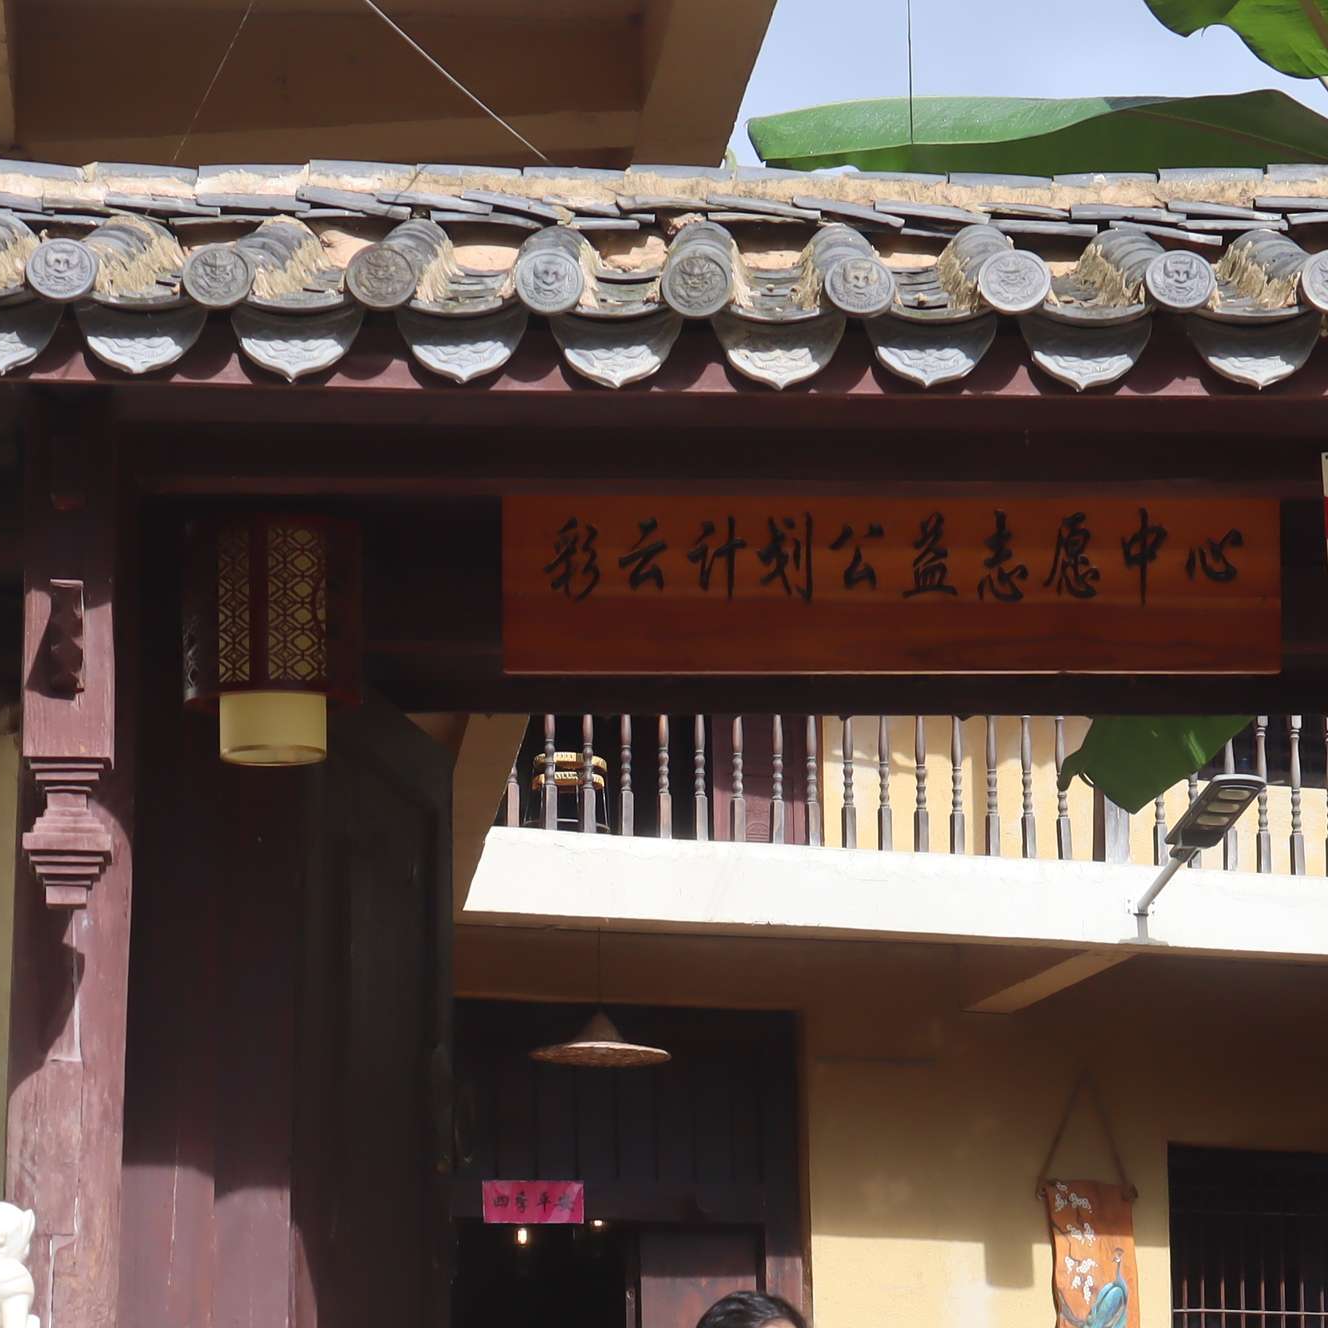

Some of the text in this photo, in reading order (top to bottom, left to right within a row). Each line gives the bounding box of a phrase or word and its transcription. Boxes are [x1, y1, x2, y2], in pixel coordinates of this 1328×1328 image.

[543, 507, 1243, 606] 彩云计划公益志愿中心
